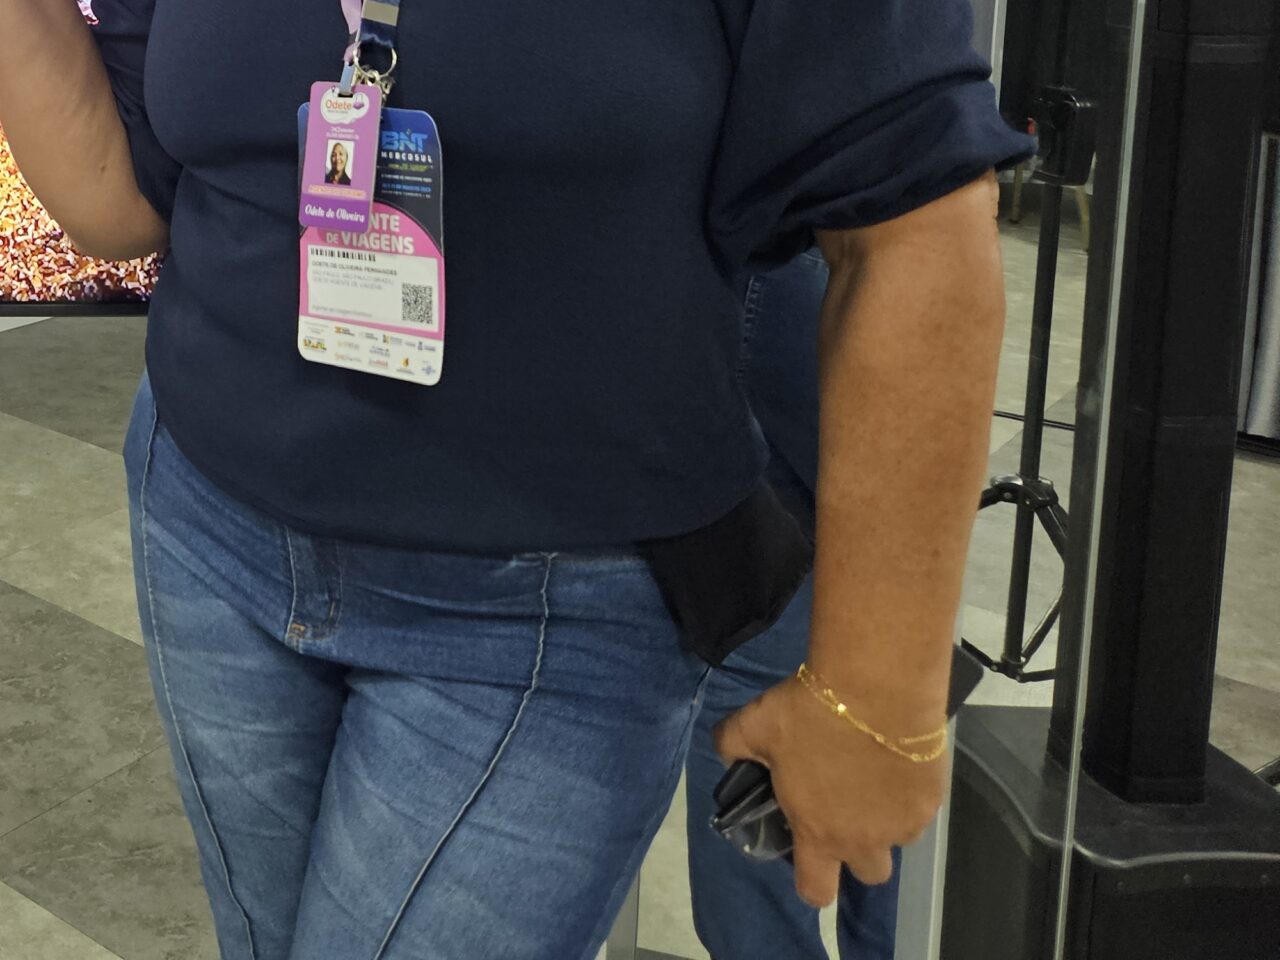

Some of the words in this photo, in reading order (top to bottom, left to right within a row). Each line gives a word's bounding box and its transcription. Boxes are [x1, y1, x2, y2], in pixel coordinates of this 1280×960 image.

[325, 99, 352, 111] Odete
[381, 130, 429, 153] BNT
[381, 151, 433, 164] MERCOSUL
[304, 203, 325, 218] Odete
[336, 207, 366, 224] Oliveira
[370, 212, 400, 233] NTE
[326, 231, 339, 244] DE
[341, 231, 415, 255] VIAGENS
